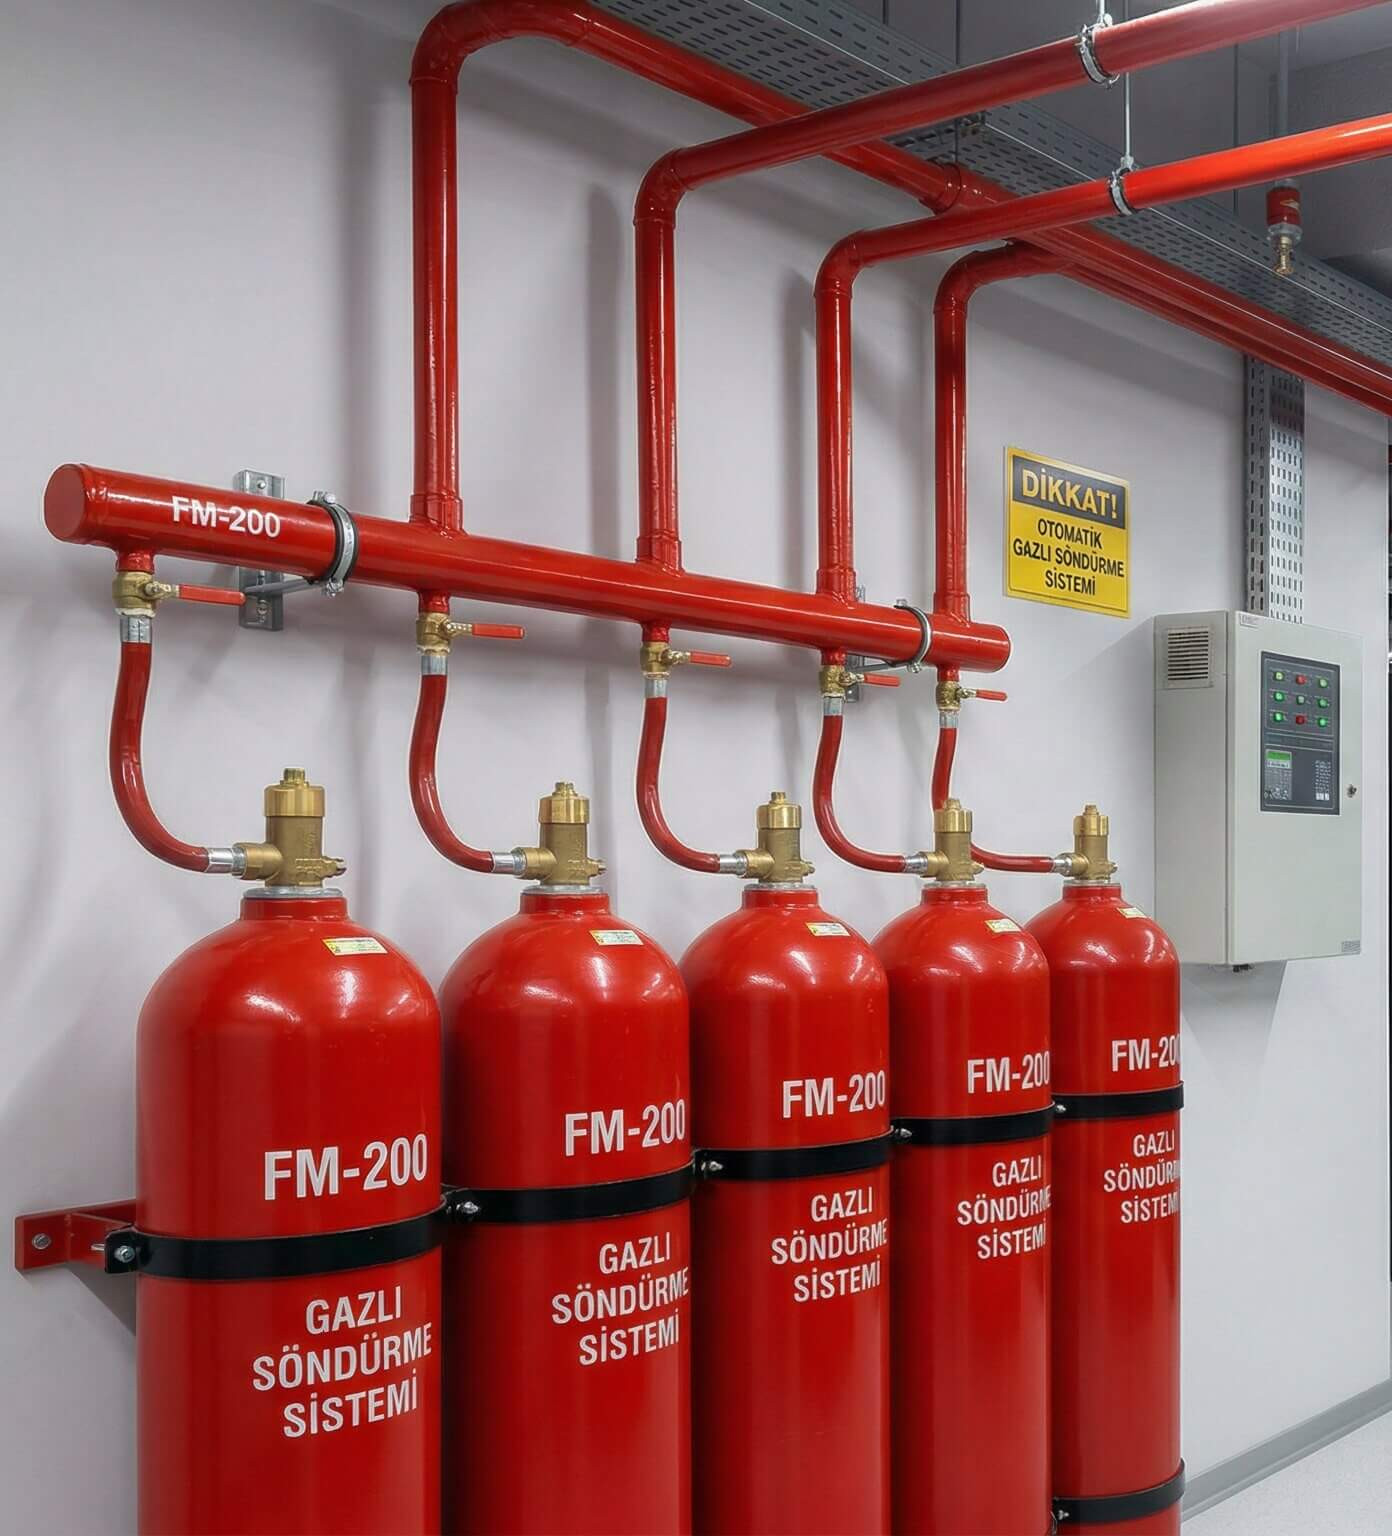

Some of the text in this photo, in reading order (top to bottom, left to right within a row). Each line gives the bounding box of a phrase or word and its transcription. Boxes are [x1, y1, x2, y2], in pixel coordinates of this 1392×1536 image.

[1021, 467, 1118, 520] DİKKAT!
[171, 495, 281, 538] FM-200
[1037, 518, 1103, 549] OTOMATİK
[1013, 538, 1124, 578] GAZLI SÖNDÜRME
[1045, 567, 1096, 596] SİSTEMİ
[967, 1050, 1050, 1094] FM-200
[782, 1070, 886, 1119] FM-200
[565, 1098, 686, 1157] FM-200
[1133, 1130, 1175, 1158] GAZLI
[264, 1133, 428, 1201] FM-200
[992, 1155, 1042, 1188] GAZLI
[1103, 1158, 1180, 1193] SÖNDÜR
[811, 1186, 873, 1222] GAZLI
[957, 1184, 1051, 1226] SÖNDÜRME
[599, 1231, 671, 1274] GAZLI
[771, 1218, 888, 1265] SÖNDÜRME
[977, 1217, 1046, 1260] SİSTEMİ
[551, 1266, 689, 1324] SÖNDÜRME
[794, 1254, 881, 1302] SİSTEMİ
[306, 1285, 401, 1335] GAZLI
[252, 1322, 432, 1391] SÖNDÜRME
[579, 1307, 679, 1366] SİSTEMİ
[283, 1367, 417, 1438] SİSTEMİ
